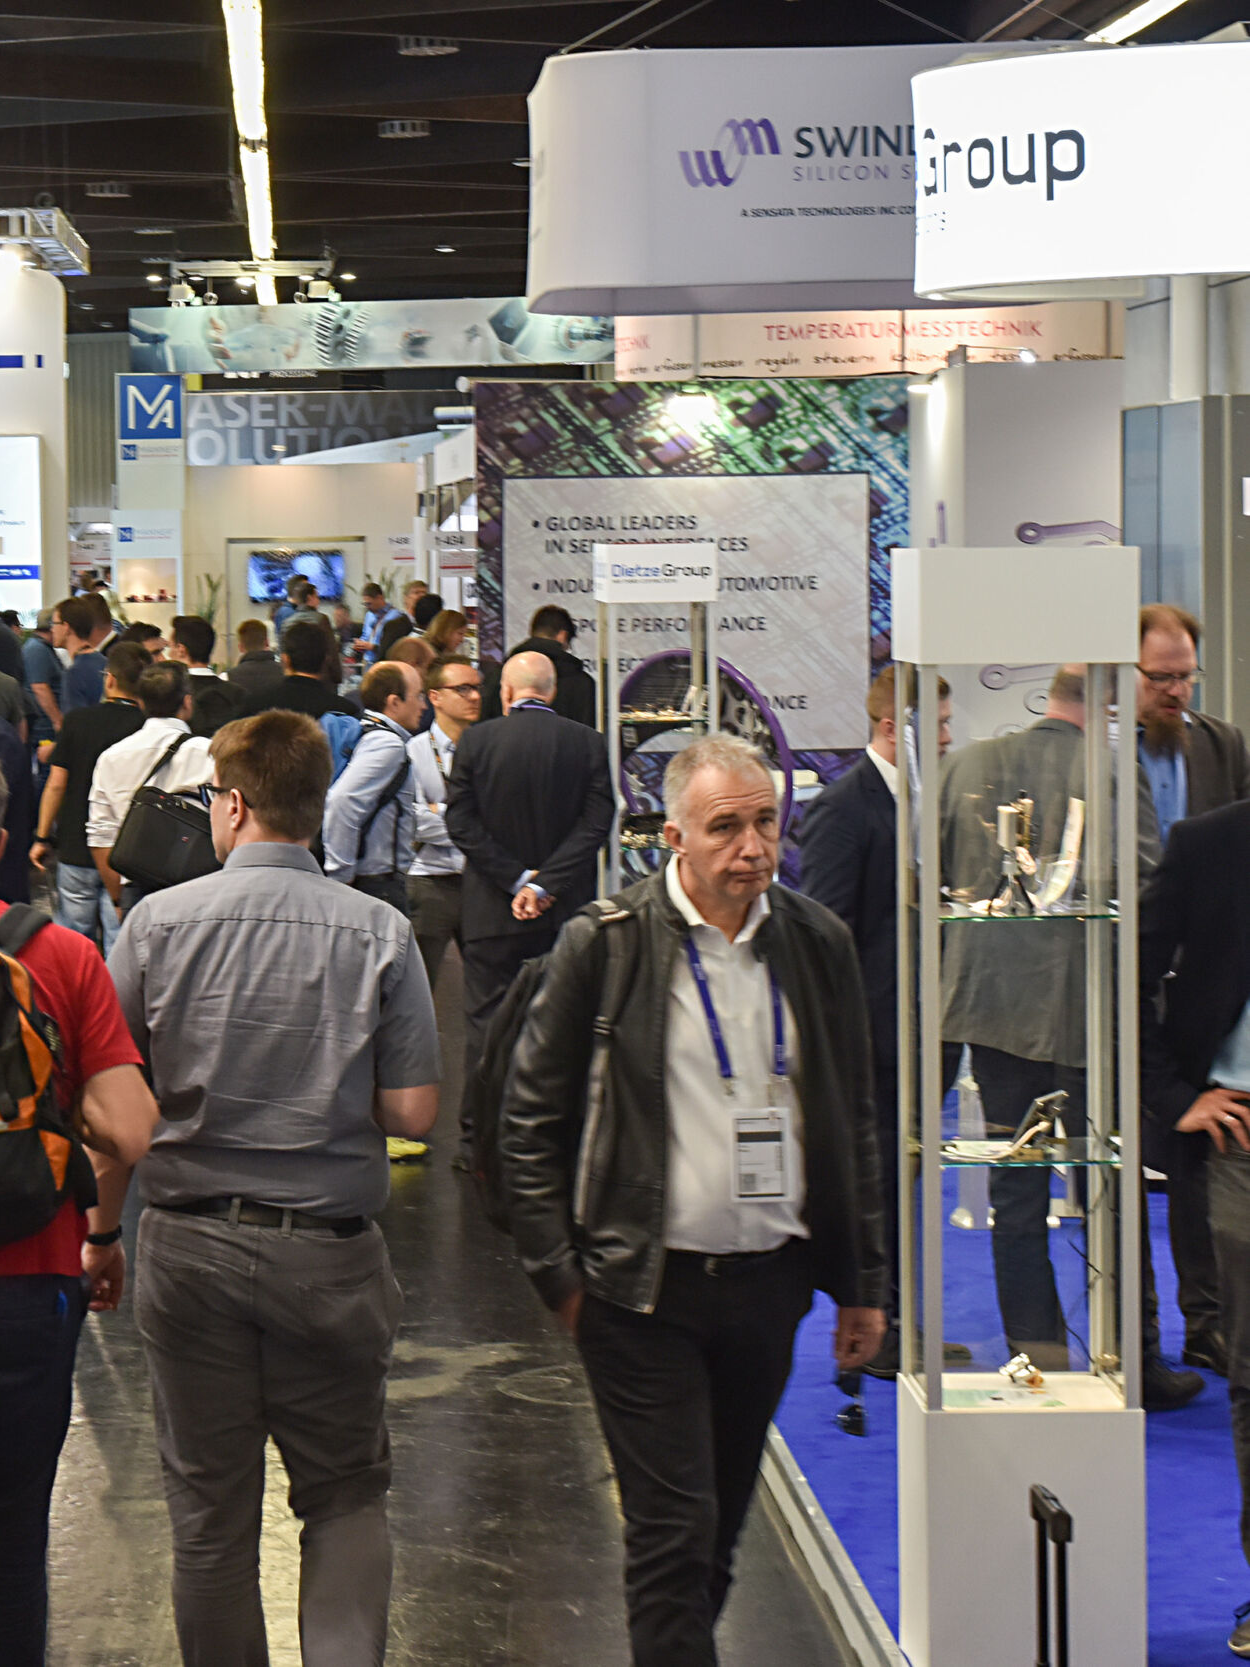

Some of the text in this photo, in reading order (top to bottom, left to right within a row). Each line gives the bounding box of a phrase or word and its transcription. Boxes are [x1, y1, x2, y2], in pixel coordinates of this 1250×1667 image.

[923, 128, 1086, 201] Group
[792, 165, 890, 182] SILICON
[798, 206, 875, 217] TECHNOLOGIES
[763, 319, 1043, 342] TEMPERATURMESSTECHNIK
[546, 515, 698, 531] GLOBAL LEADERS
[545, 539, 564, 553] IN
[631, 616, 767, 632] PERFOANCE
